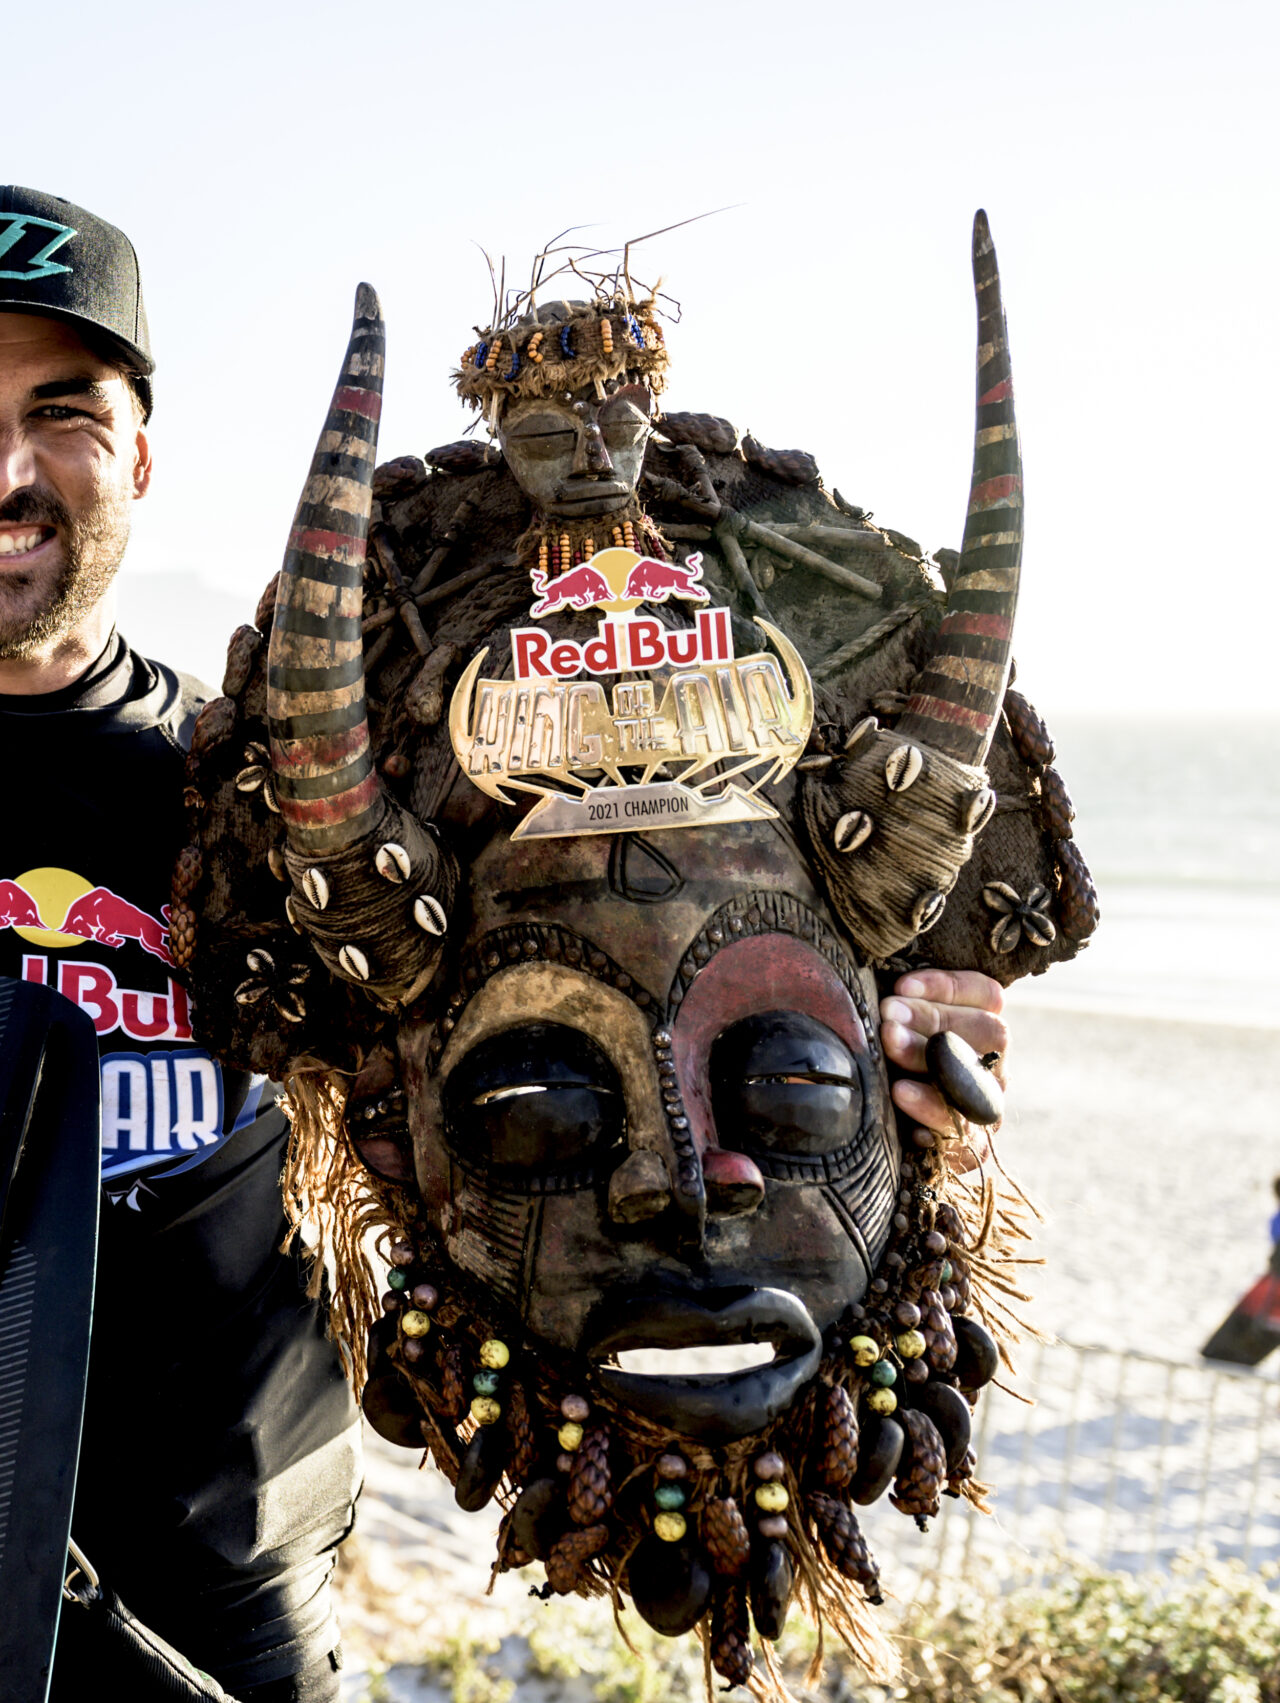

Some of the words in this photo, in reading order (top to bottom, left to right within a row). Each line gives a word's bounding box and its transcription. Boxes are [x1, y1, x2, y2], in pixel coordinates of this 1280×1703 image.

[515, 622, 619, 678] Red
[628, 611, 730, 667] Bull
[469, 684, 604, 775] KING
[612, 717, 667, 752] THE
[617, 685, 652, 715] OF
[676, 662, 801, 756] AIR
[588, 803, 620, 821] 2021
[624, 798, 689, 817] CHAMPION
[60, 963, 194, 1039] Bul
[101, 1056, 220, 1152] AIR
